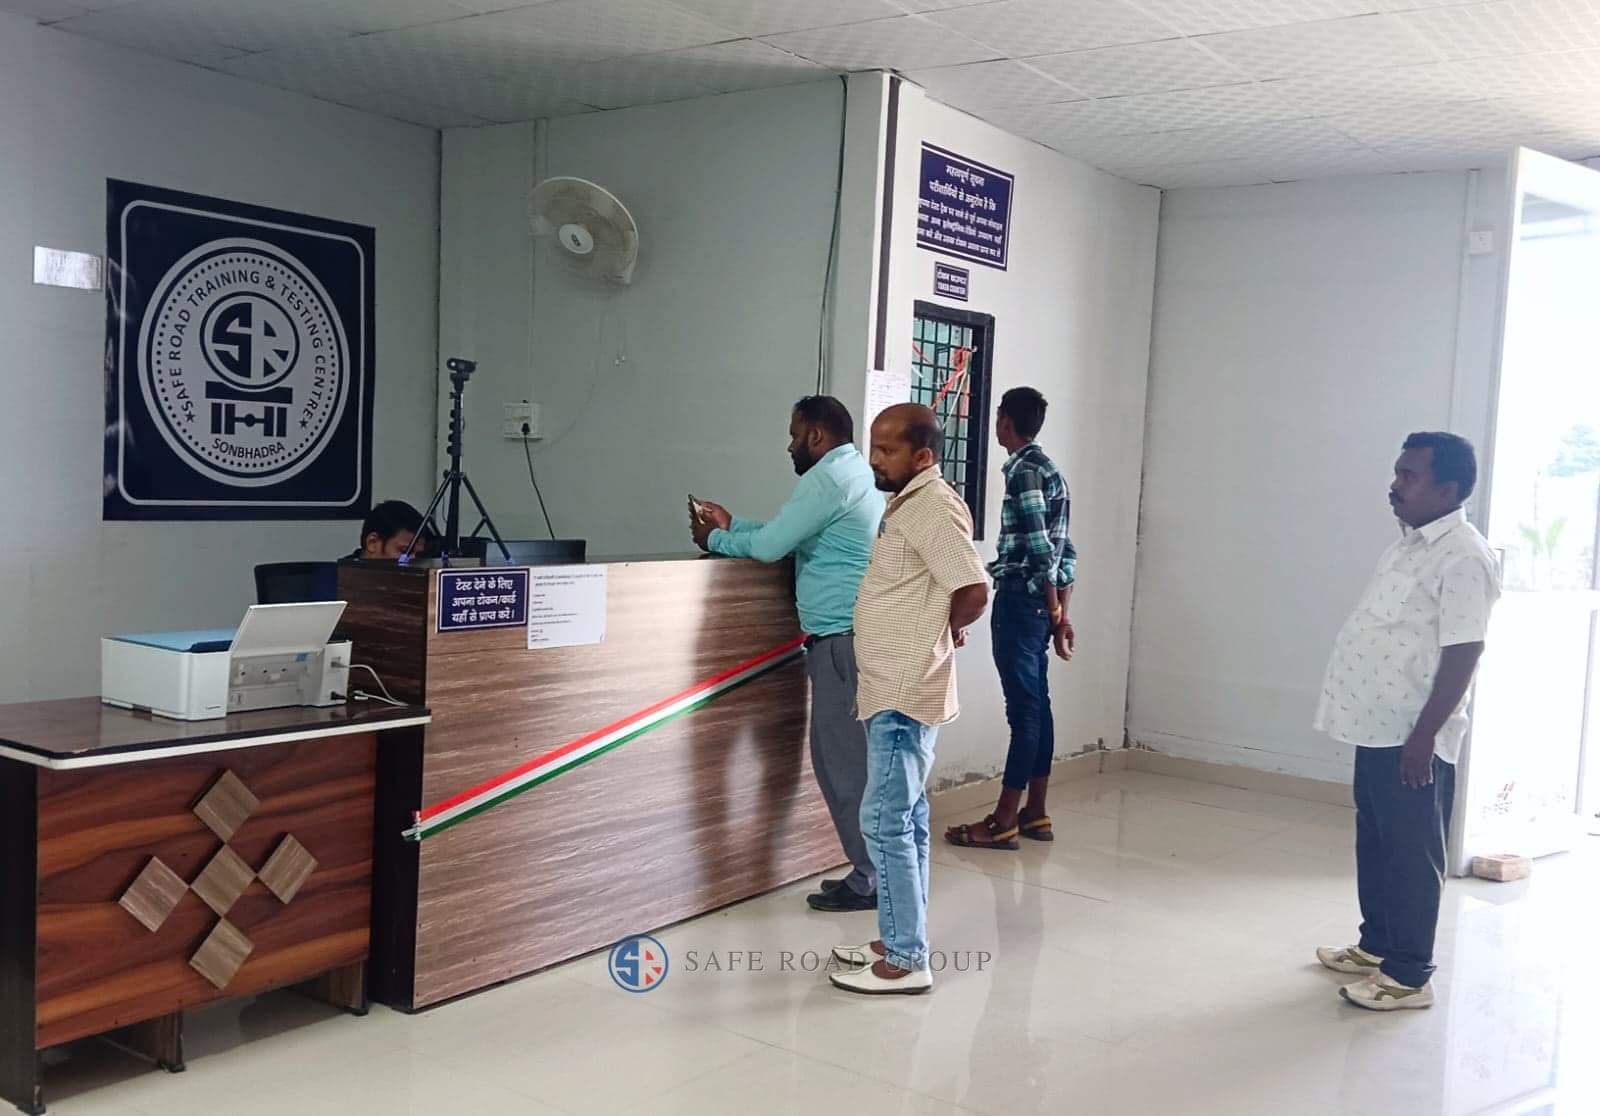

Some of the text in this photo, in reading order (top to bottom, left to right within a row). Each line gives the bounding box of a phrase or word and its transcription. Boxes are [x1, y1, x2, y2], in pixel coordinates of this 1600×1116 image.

[169, 270, 326, 420] SAFE ROAD TRAINING & TESTING CENTRE
[212, 438, 285, 459] SONBHADRA
[456, 576, 513, 591] टेस्ट देने के लिए
[452, 596, 475, 607] अपना
[469, 608, 477, 621] से
